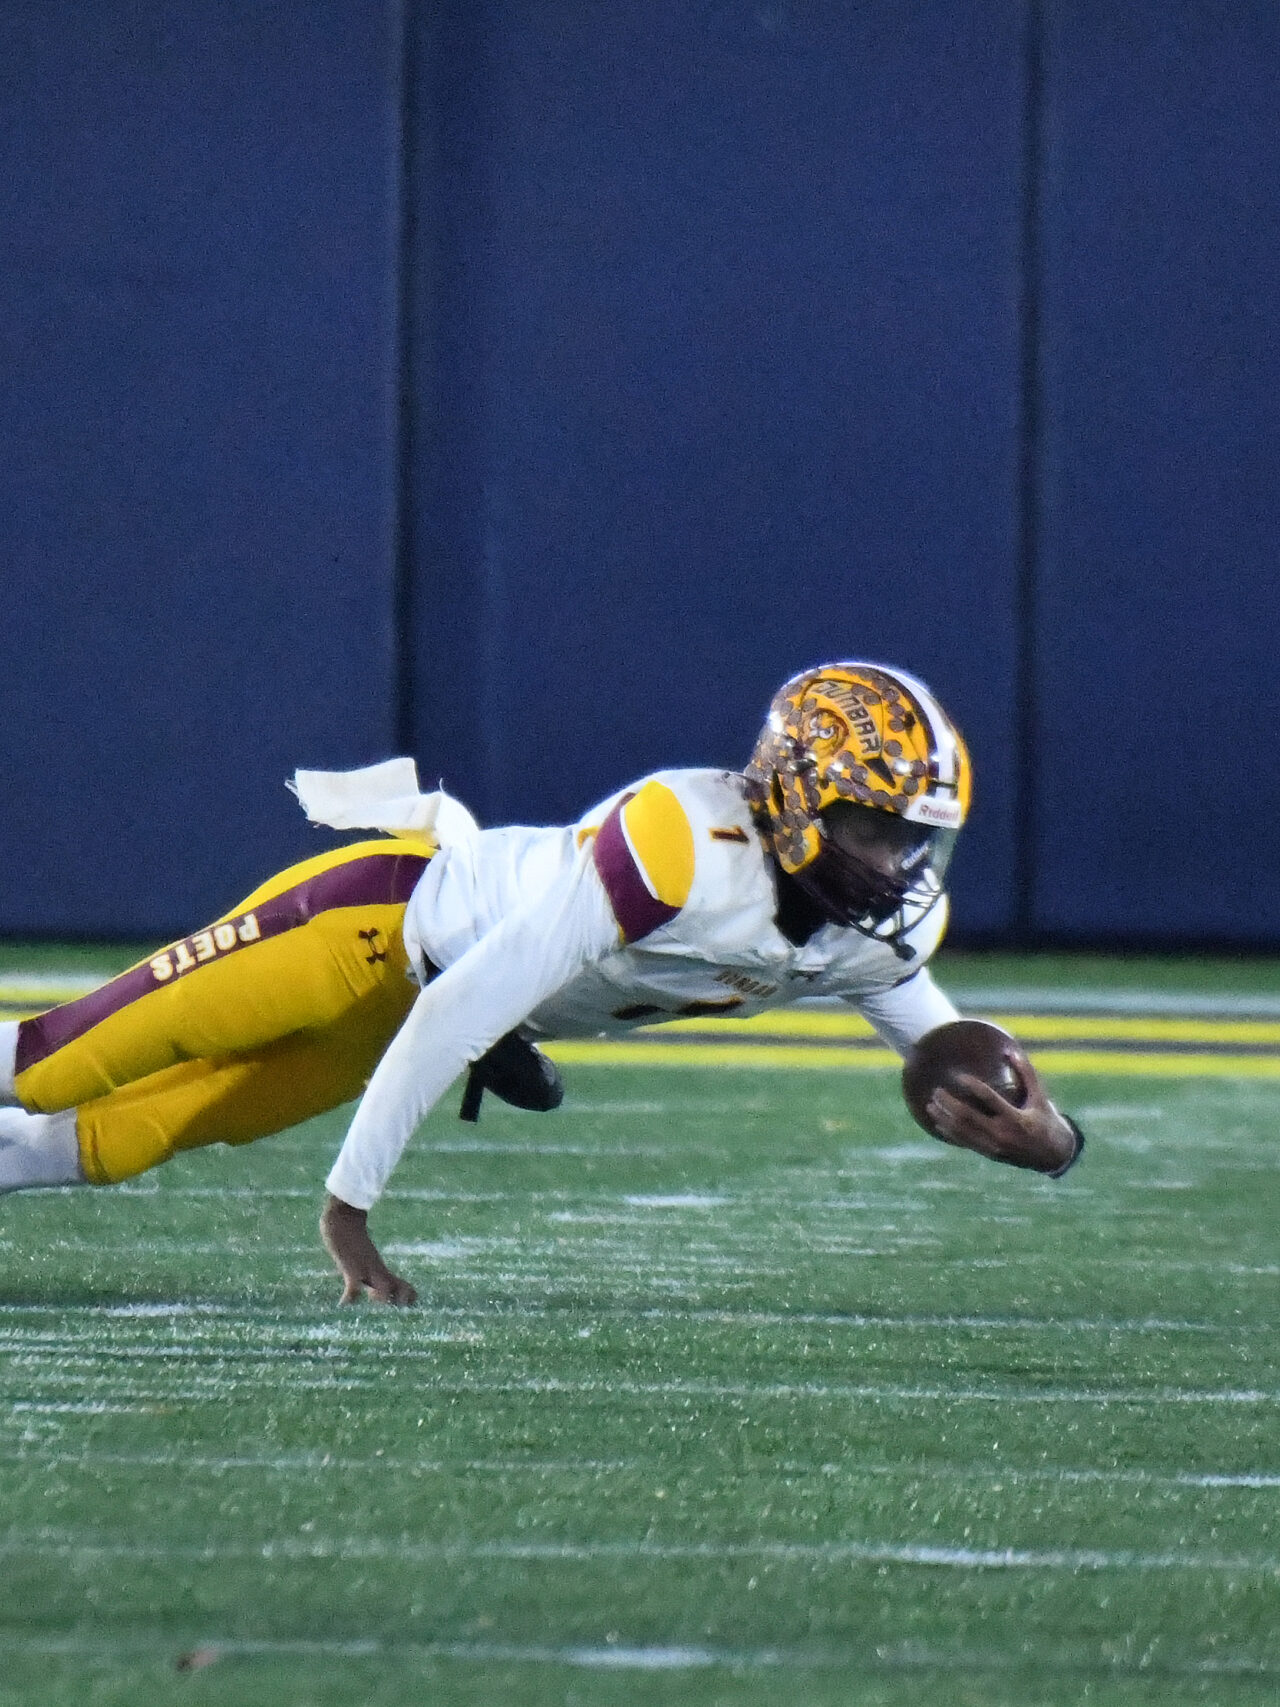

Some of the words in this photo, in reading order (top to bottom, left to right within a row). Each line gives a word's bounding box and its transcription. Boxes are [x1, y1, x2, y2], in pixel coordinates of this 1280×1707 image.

[810, 680, 881, 755] DUNBAR
[708, 825, 749, 844] 1
[149, 913, 261, 982] POETS
